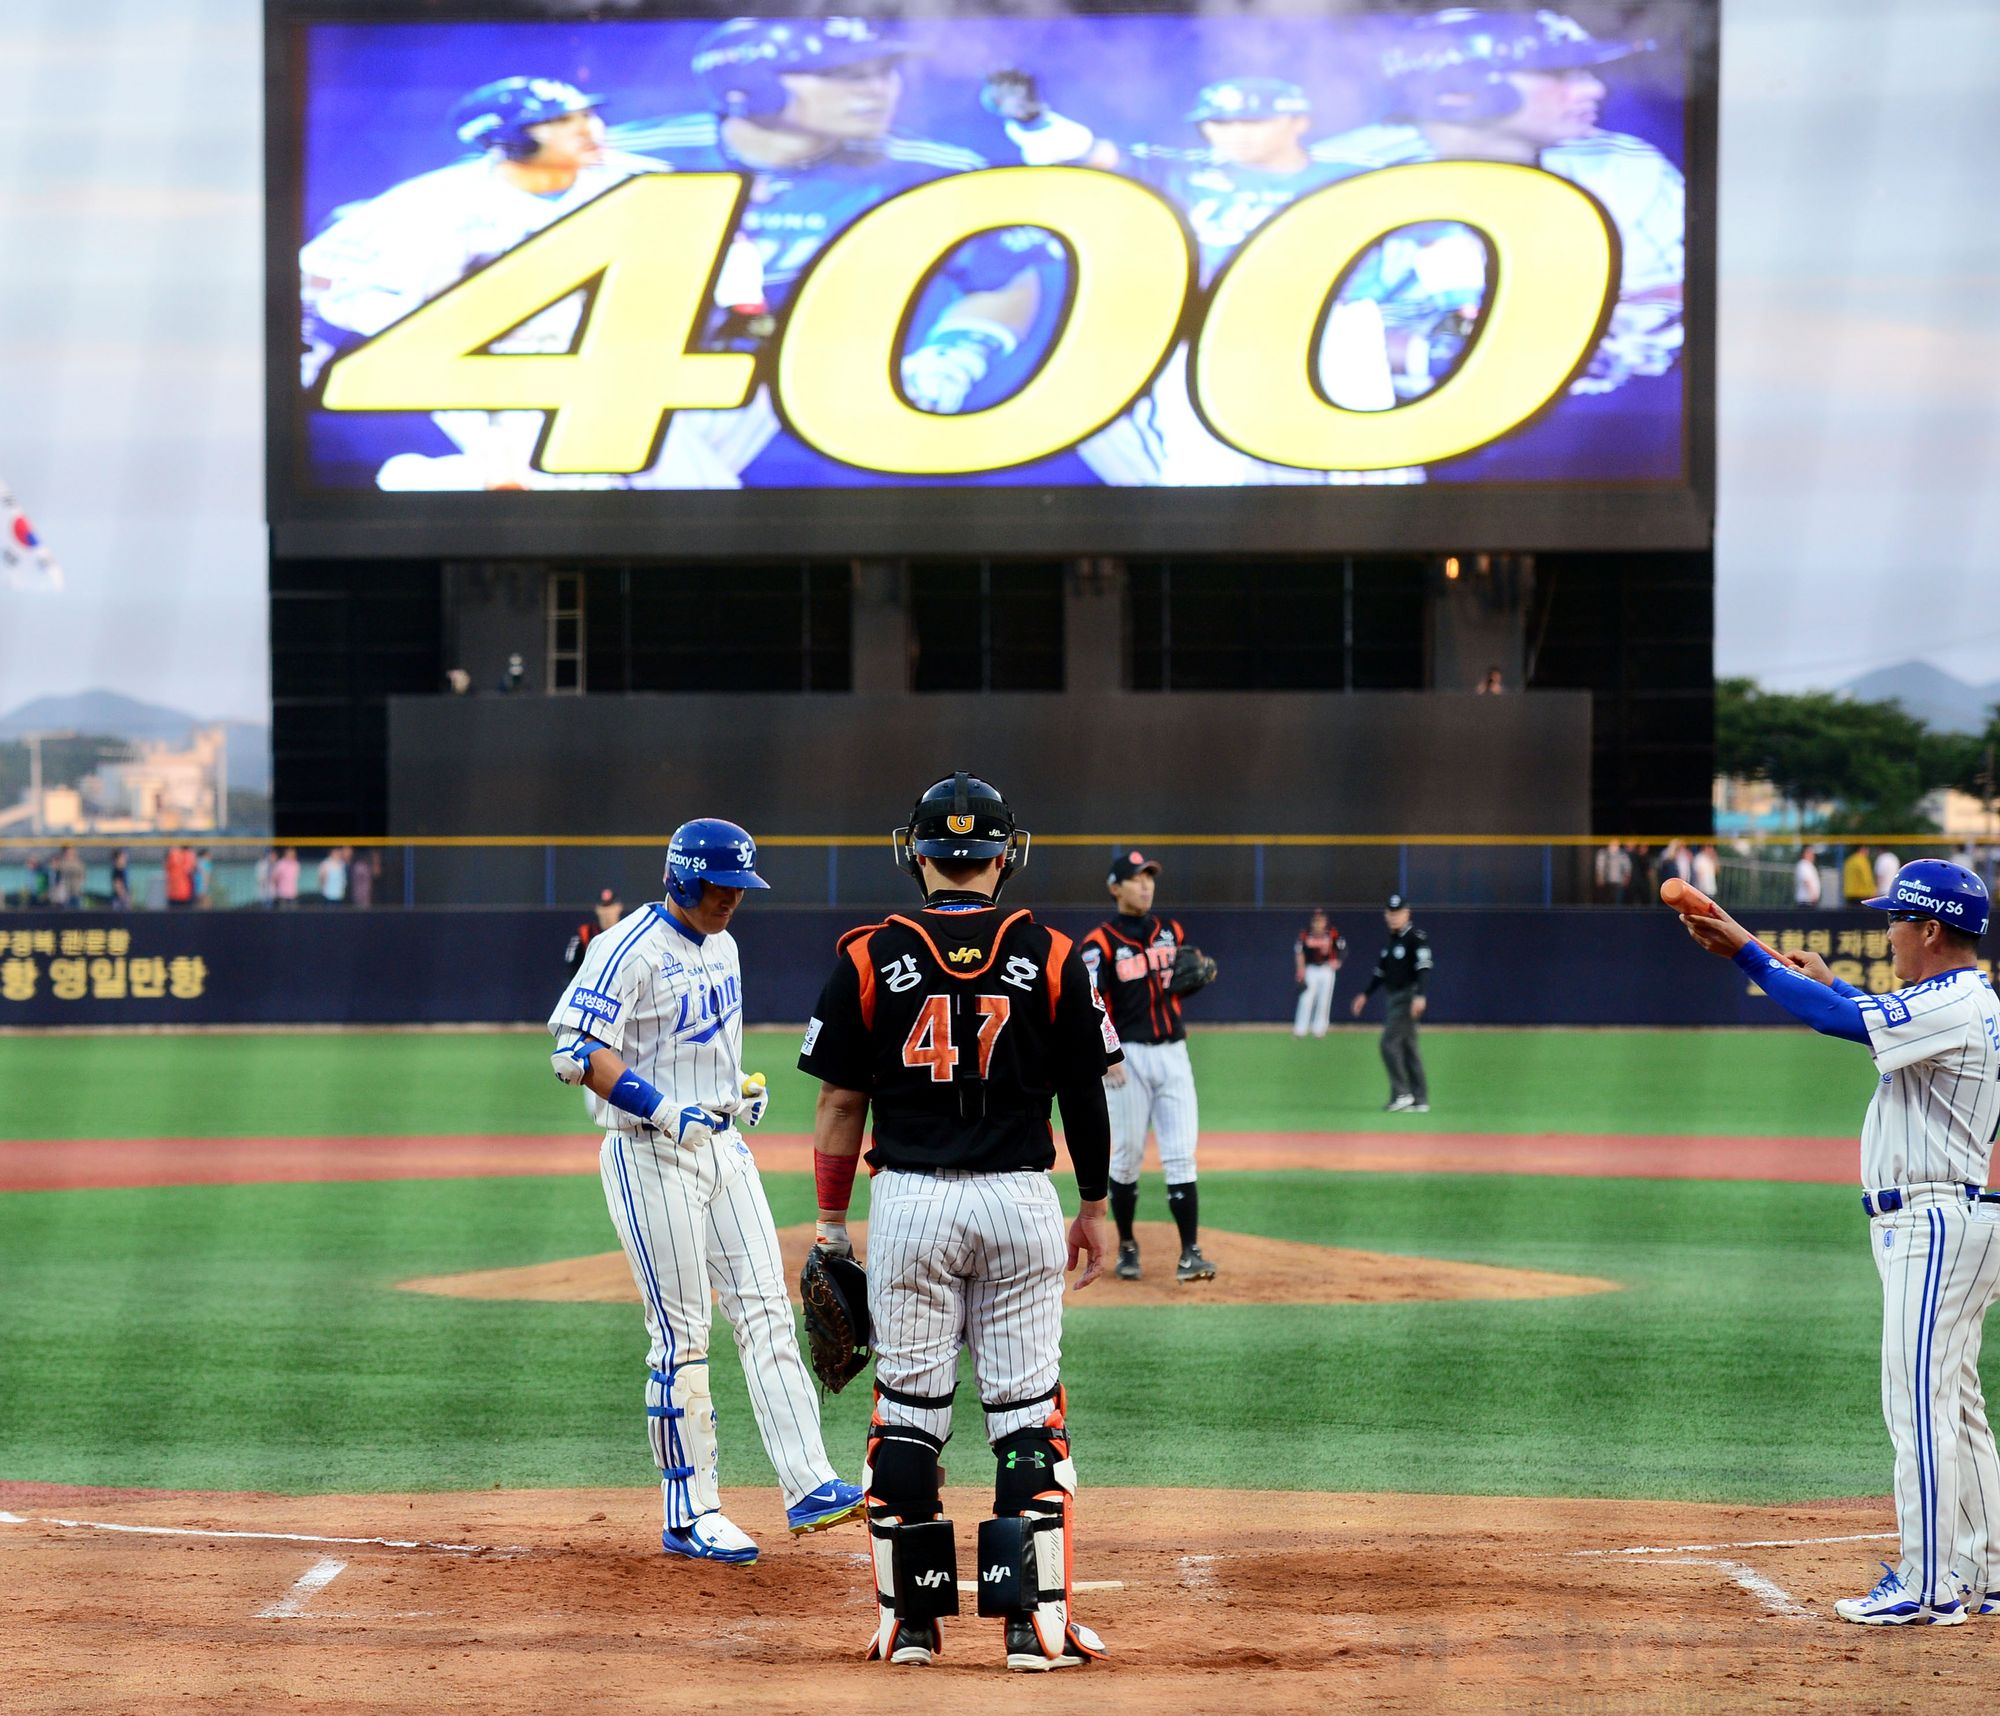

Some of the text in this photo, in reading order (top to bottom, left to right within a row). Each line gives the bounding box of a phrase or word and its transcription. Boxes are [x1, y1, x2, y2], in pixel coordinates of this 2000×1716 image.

[318, 160, 1618, 475] 400
[692, 856, 707, 870] S6
[1897, 888, 1964, 915] Galaxy S6
[0, 956, 209, 1001] 항 영일만항
[880, 953, 923, 993] 강
[1000, 955, 1040, 992] 호
[574, 990, 618, 1020] 삼성화재
[669, 973, 742, 1037] Lion
[902, 994, 1011, 1083] 47
